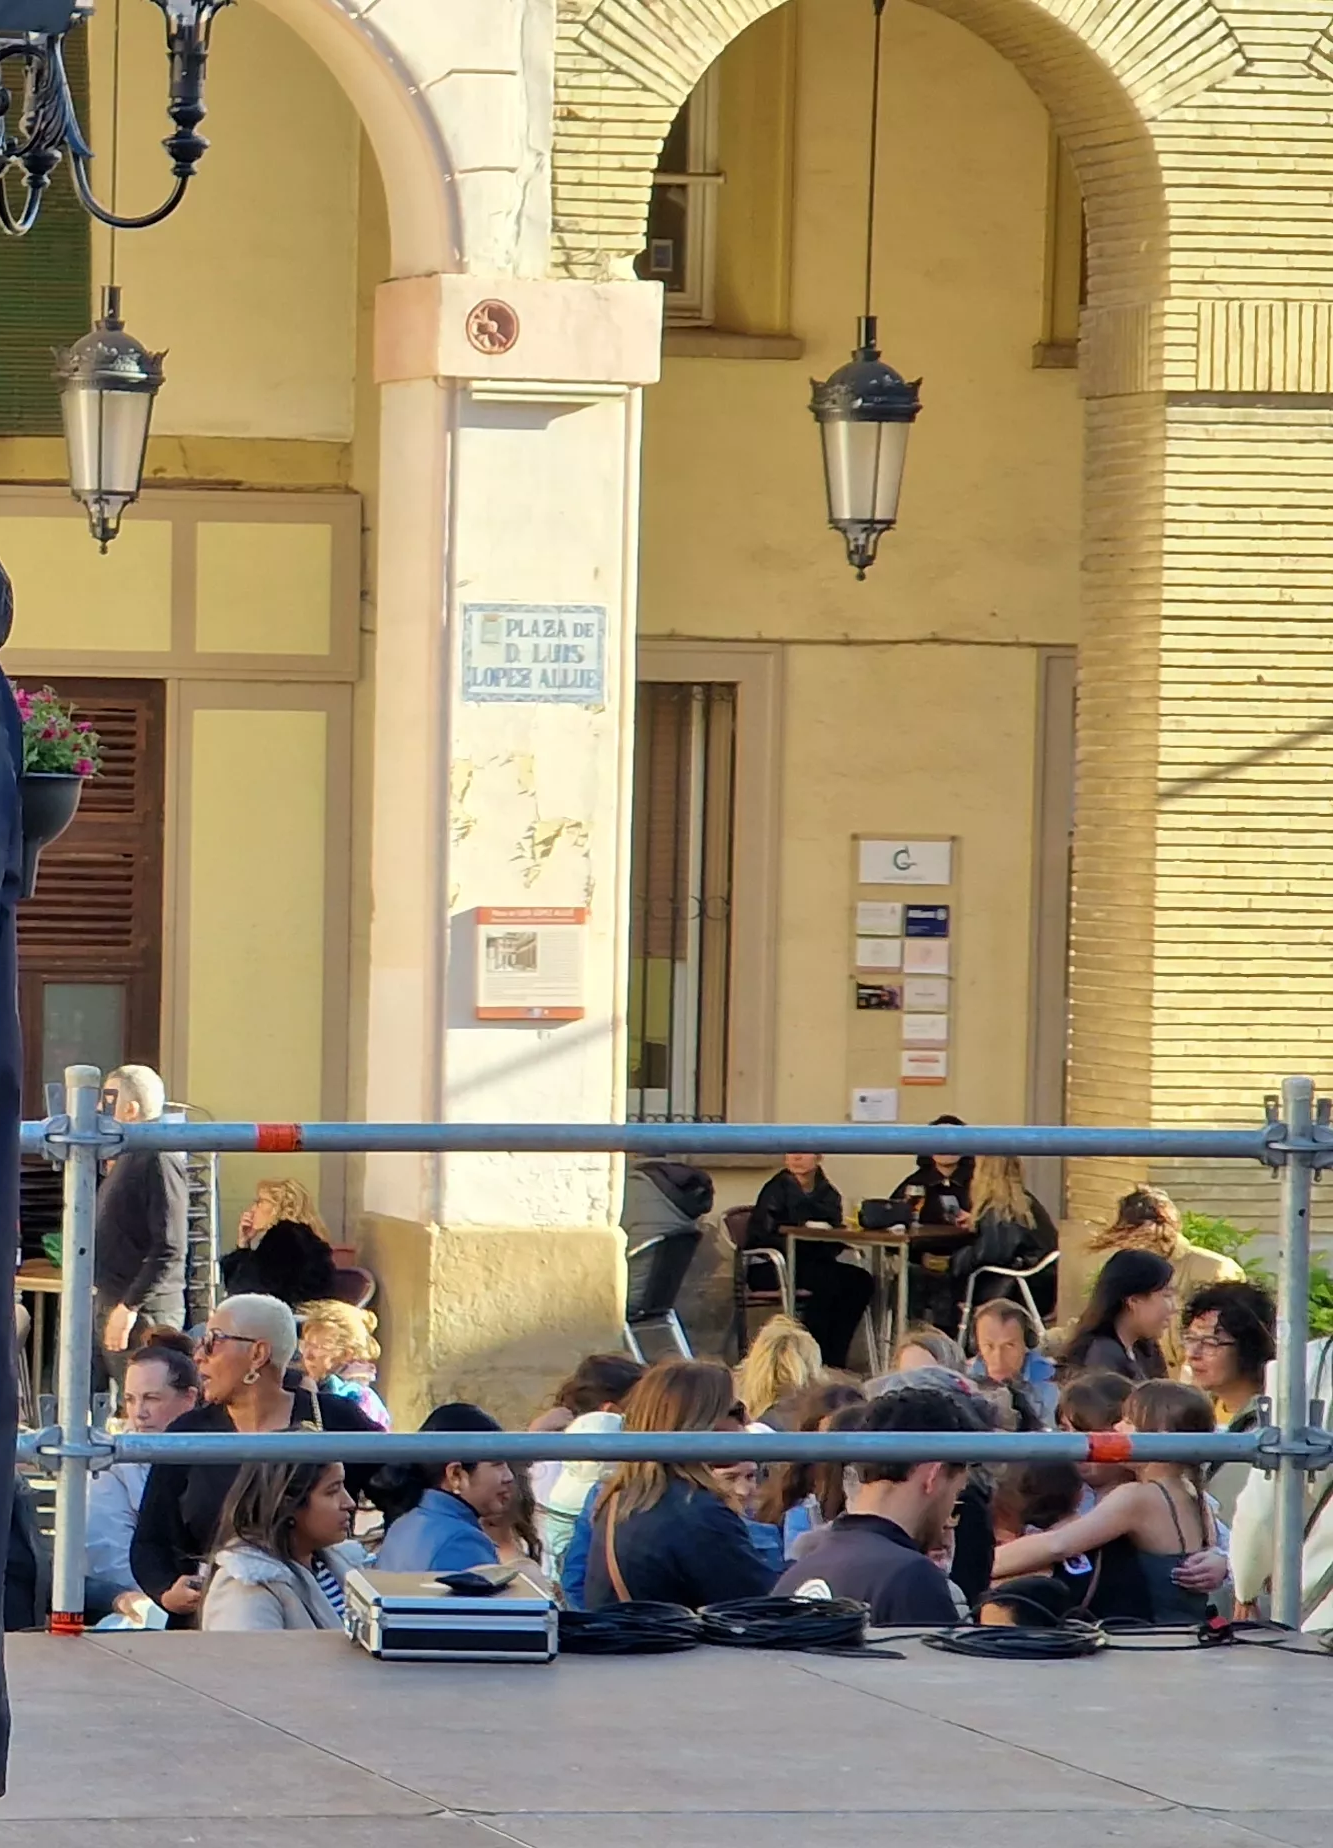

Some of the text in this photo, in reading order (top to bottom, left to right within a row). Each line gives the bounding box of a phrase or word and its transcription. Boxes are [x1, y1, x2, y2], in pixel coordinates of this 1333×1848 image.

[505, 618, 595, 638] PLAZA DE
[531, 643, 585, 664] LUIS
[471, 667, 532, 688] LOPEZ
